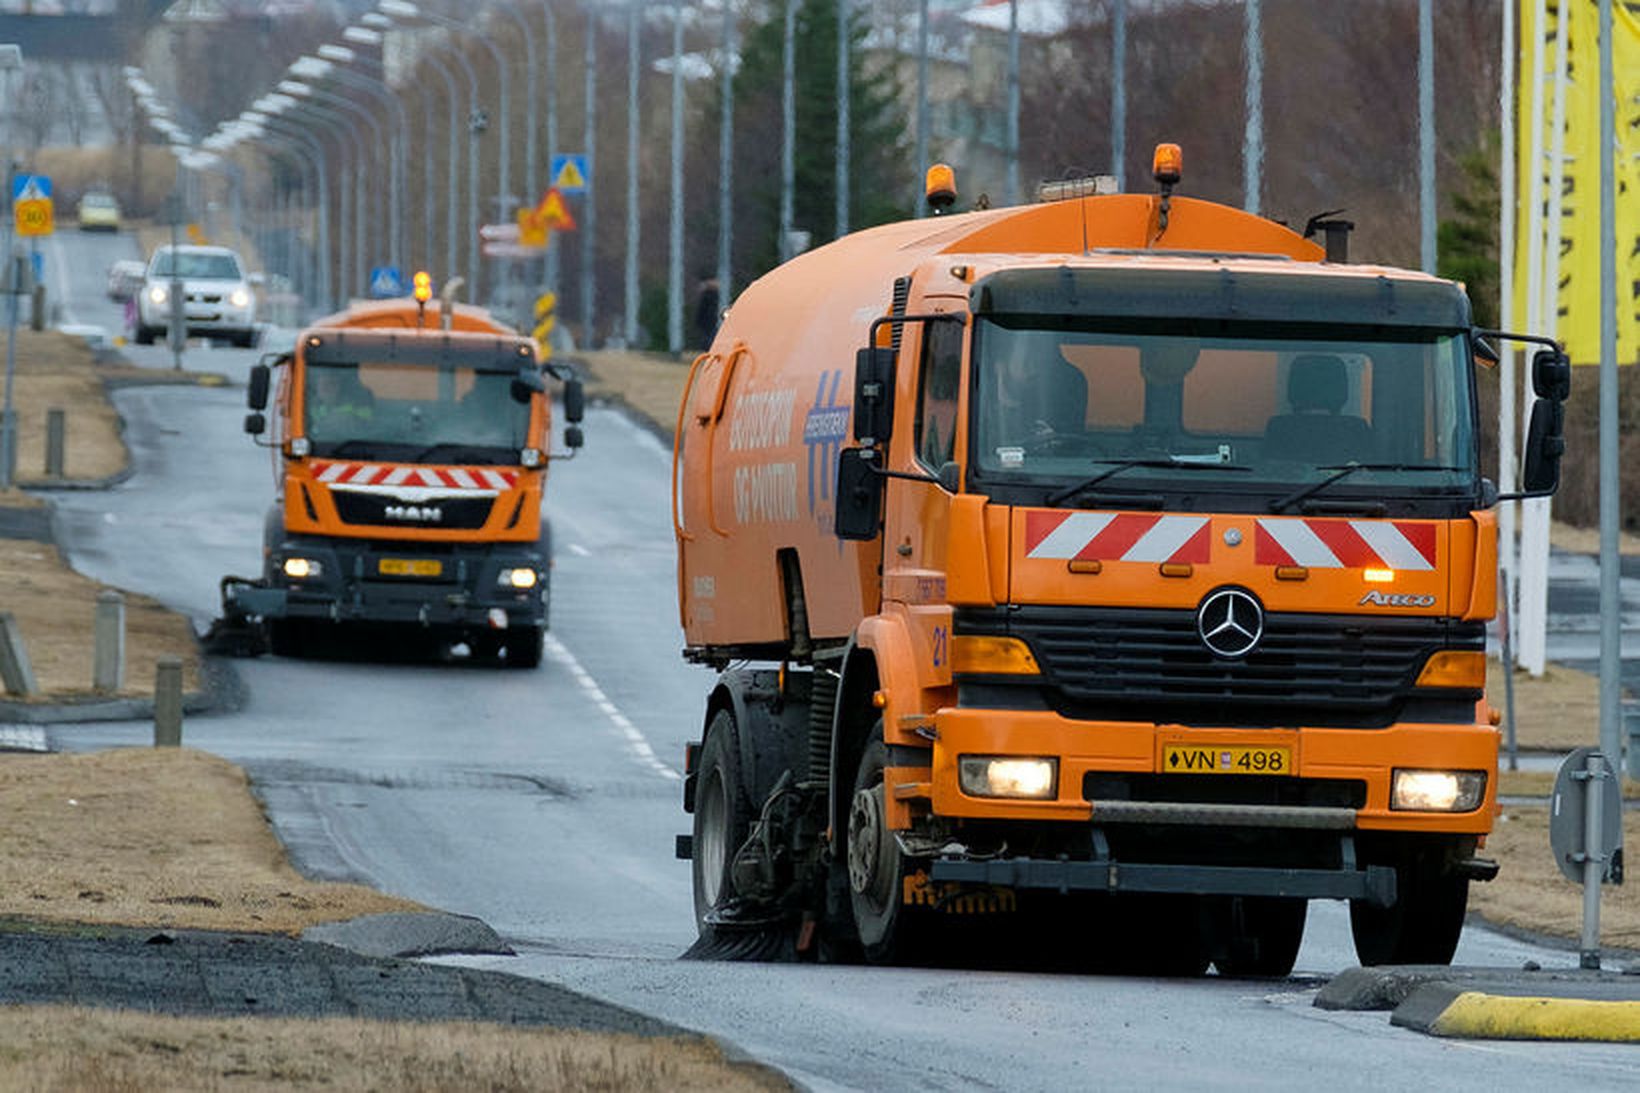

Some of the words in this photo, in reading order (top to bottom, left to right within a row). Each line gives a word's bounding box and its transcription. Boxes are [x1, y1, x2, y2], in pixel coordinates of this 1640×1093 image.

[385, 506, 442, 521] MAN
[933, 625, 947, 667] 21
[1182, 751, 1215, 769] VN
[1237, 751, 1283, 771] 498
